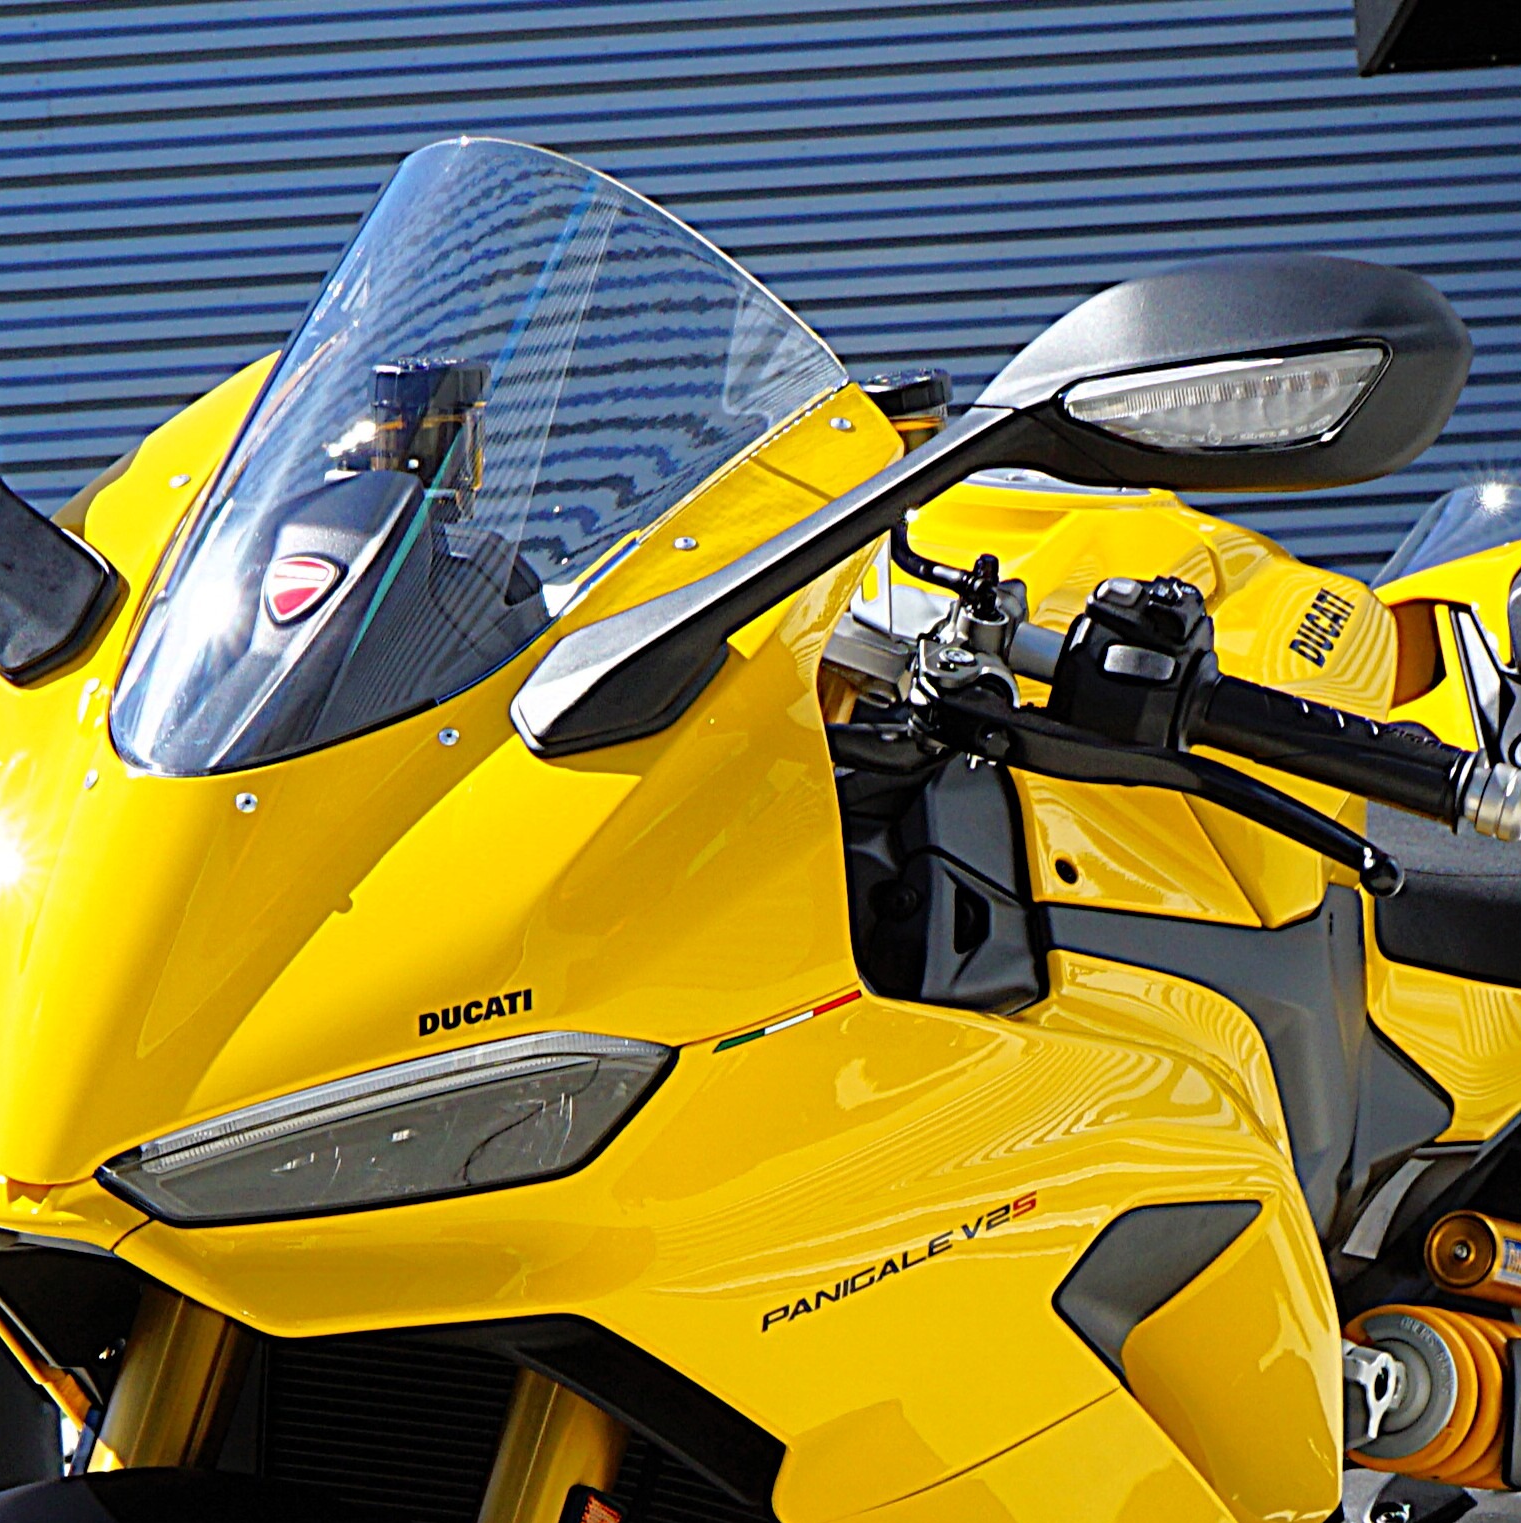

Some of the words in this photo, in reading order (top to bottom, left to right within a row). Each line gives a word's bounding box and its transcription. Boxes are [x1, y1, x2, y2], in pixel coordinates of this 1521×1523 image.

[1289, 587, 1355, 668] DUCATI
[418, 988, 532, 1036] DUCATI
[761, 1230, 954, 1333] PANIGALE
